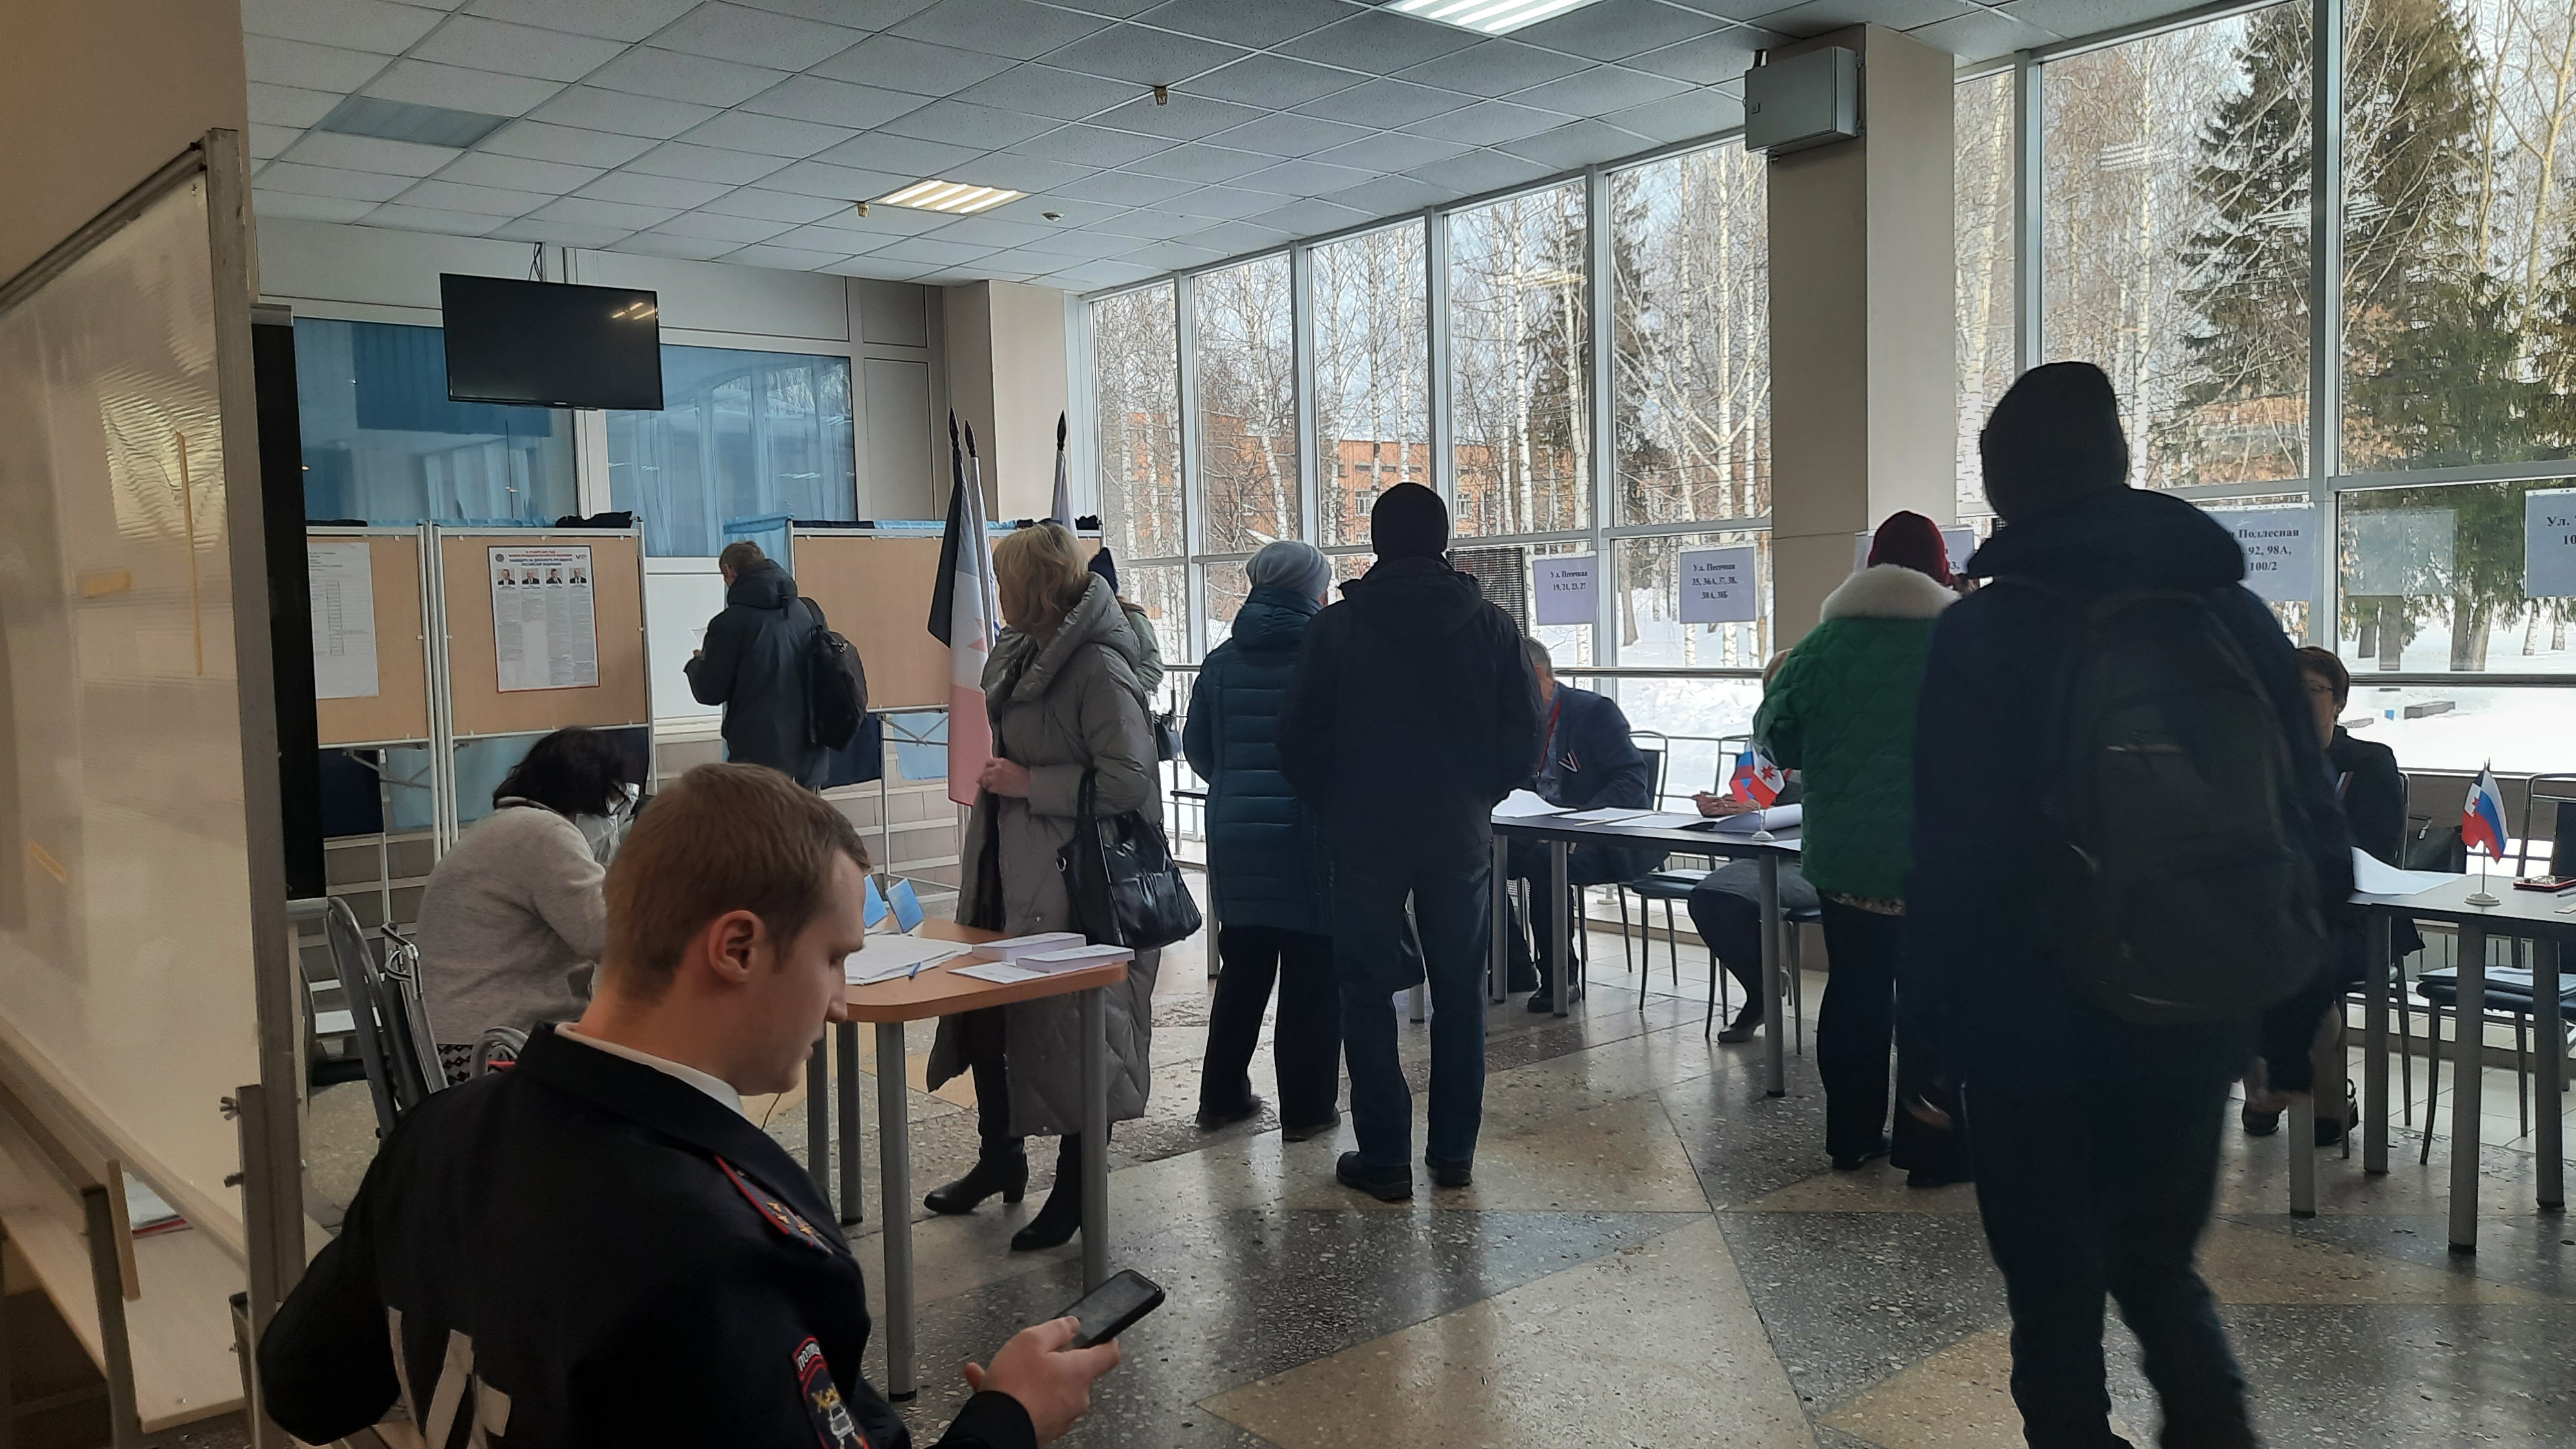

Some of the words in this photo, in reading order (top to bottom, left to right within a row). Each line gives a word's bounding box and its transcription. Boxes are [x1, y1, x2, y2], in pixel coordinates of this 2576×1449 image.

[2546, 516, 2571, 527] Ул.
[2248, 546, 2264, 556] 92,
[2249, 562, 2277, 571] 100/2
